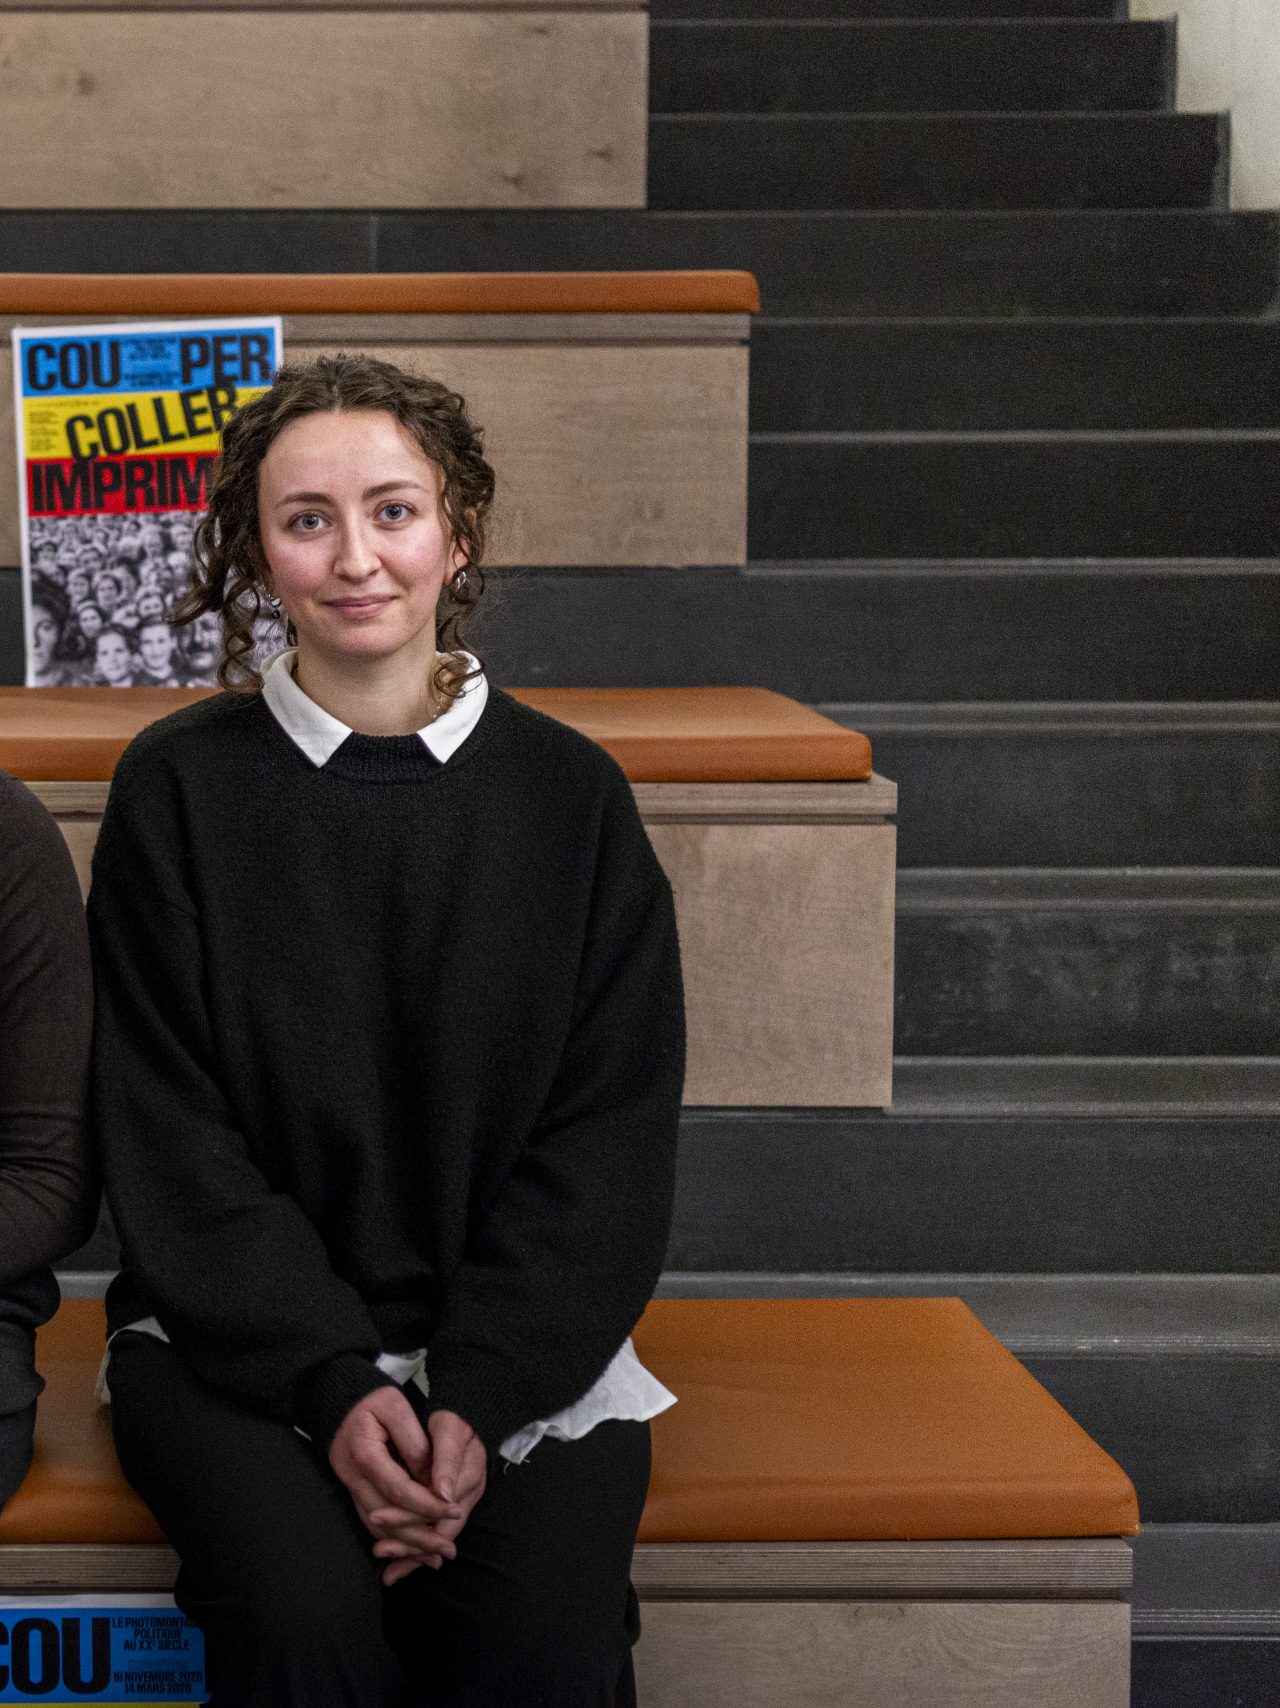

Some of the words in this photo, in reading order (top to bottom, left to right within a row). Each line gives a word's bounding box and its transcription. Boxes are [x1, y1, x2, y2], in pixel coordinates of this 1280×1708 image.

[28, 340, 120, 390] COU
[180, 334, 271, 386] PER
[66, 386, 238, 463] COLLER
[31, 459, 214, 511] IMPRIM
[112, 1617, 123, 1628] LE
[134, 1628, 183, 1639] POLITIQUE
[124, 1639, 136, 1650] AU
[124, 1672, 177, 1683] NOVEMBRE
[178, 1671, 203, 1683] 2025
[125, 1683, 135, 1694] 14
[137, 1683, 165, 1694] MARS
